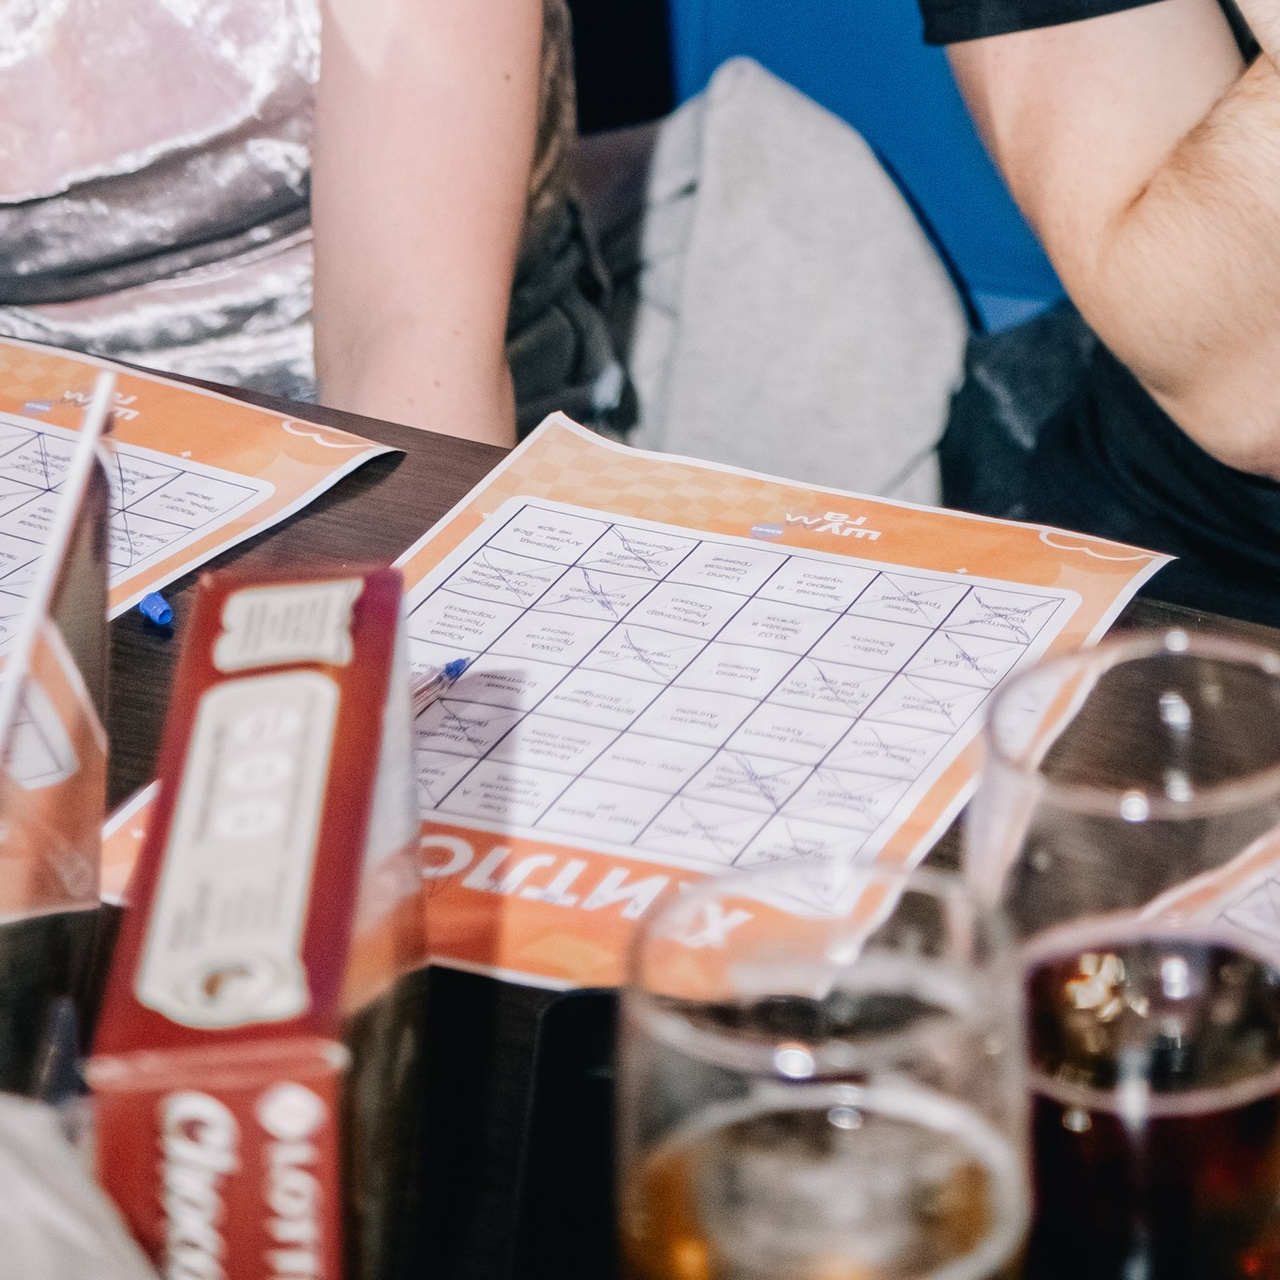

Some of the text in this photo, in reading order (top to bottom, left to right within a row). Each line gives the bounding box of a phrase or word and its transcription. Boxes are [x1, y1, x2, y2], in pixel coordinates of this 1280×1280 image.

[535, 524, 558, 532] зря
[515, 536, 563, 552] Леонид
[542, 534, 584, 547] Агутин
[703, 570, 742, 582] Louna
[420, 834, 753, 947] ХИТЛО
